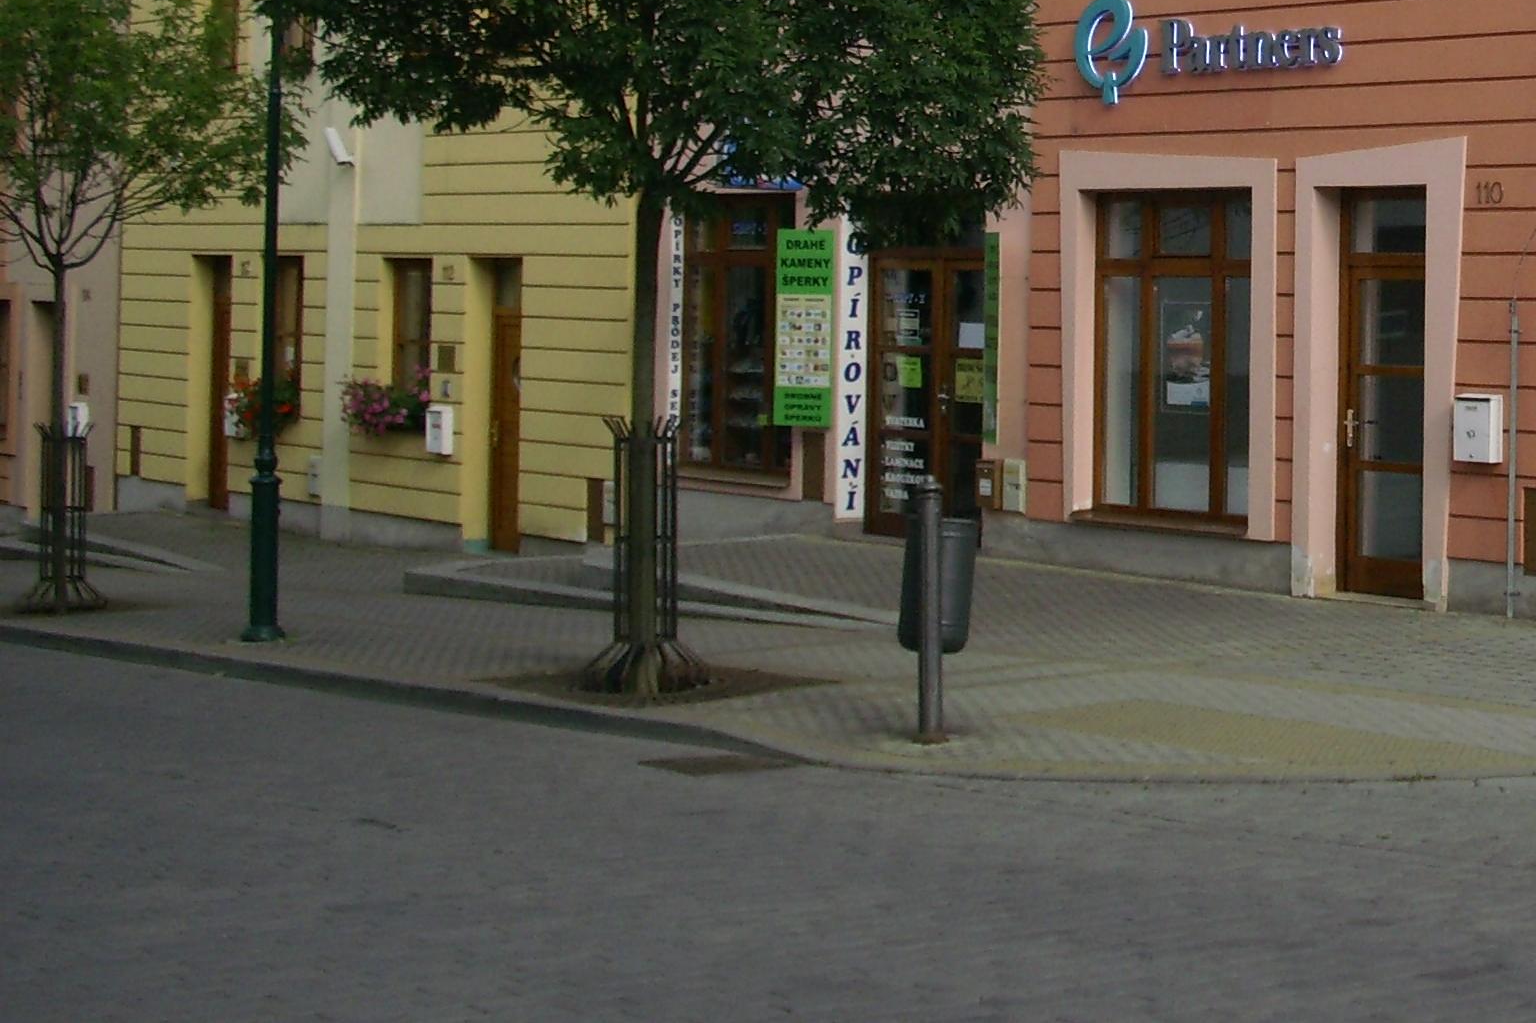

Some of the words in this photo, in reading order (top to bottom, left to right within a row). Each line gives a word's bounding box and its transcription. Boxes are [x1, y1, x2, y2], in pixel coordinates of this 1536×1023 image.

[1160, 19, 1343, 75] Partners
[1476, 182, 1503, 204] 110
[780, 257, 831, 269] KAMENY
[781, 273, 829, 287] ŠPERKY
[841, 232, 864, 510] OPÍROVÁNÍ
